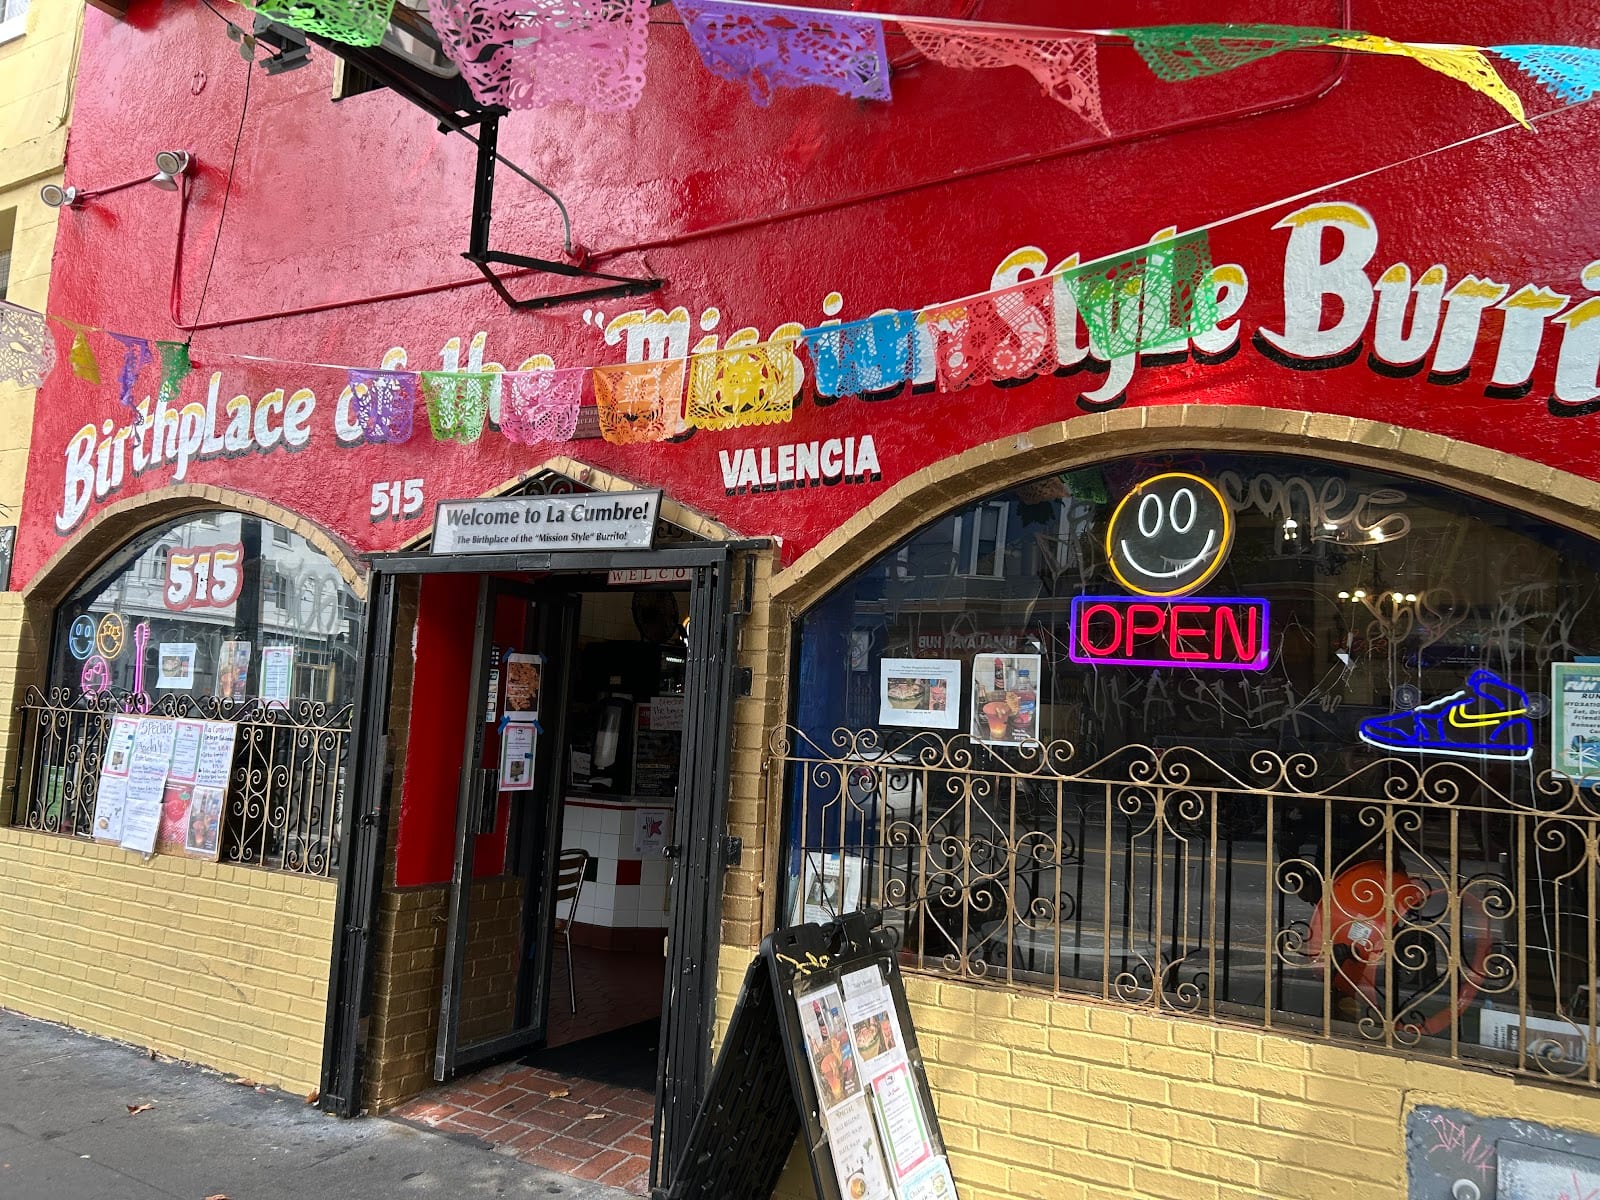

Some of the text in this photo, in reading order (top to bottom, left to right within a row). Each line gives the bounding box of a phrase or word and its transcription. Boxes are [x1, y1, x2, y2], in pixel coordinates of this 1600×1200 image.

[56, 371, 316, 532] Birthplace
[719, 434, 882, 491] VALENCIA
[370, 478, 424, 518] 515
[446, 501, 649, 527] Welcome to La Cumbre!
[457, 535, 470, 545] The
[471, 534, 509, 547] Birthplace
[511, 534, 519, 543] of
[520, 533, 533, 543] the
[535, 532, 569, 543] "Mission
[596, 530, 628, 541] Burrito!
[167, 547, 242, 609] 515
[612, 568, 686, 582] WELCO
[1081, 603, 1257, 662] OPEN
[1564, 681, 1598, 691] FUN
